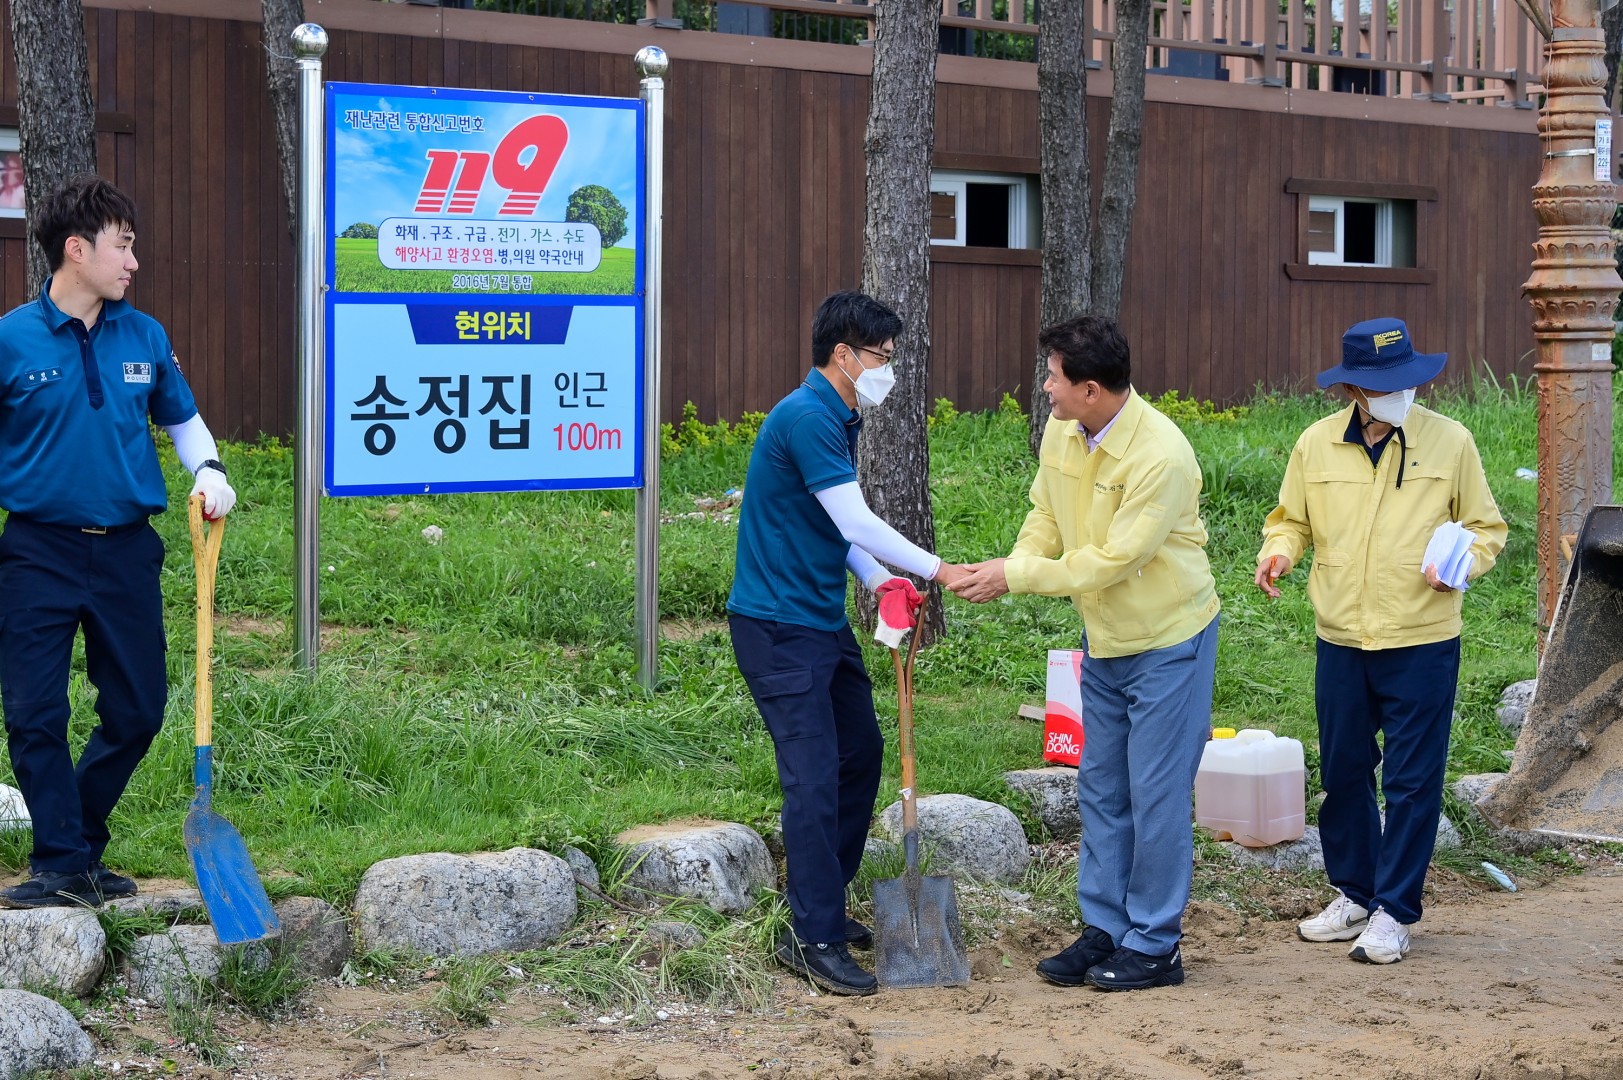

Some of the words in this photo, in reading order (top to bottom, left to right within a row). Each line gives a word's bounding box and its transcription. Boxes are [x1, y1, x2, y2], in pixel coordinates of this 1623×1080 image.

[345, 110, 400, 131] 재난관련
[406, 113, 485, 133] 통합신고번호
[414, 114, 568, 215] 119
[395, 225, 418, 241] 화재
[430, 226, 453, 241] 구조
[464, 227, 487, 243] 구급
[497, 228, 520, 244] 전기
[531, 229, 553, 244] 가스
[563, 229, 585, 244] 수도
[395, 246, 442, 263] 해양사고
[539, 249, 584, 266] 약국안내
[452, 275, 489, 289] 2016년
[493, 275, 509, 290] 7월
[512, 275, 532, 290] 통합
[455, 311, 531, 340] 현위치
[350, 374, 532, 456] 송정집
[554, 372, 608, 408] 인근
[553, 422, 622, 451] 100m
[1046, 742, 1080, 755] DONG
[1048, 732, 1072, 744] SHIN
